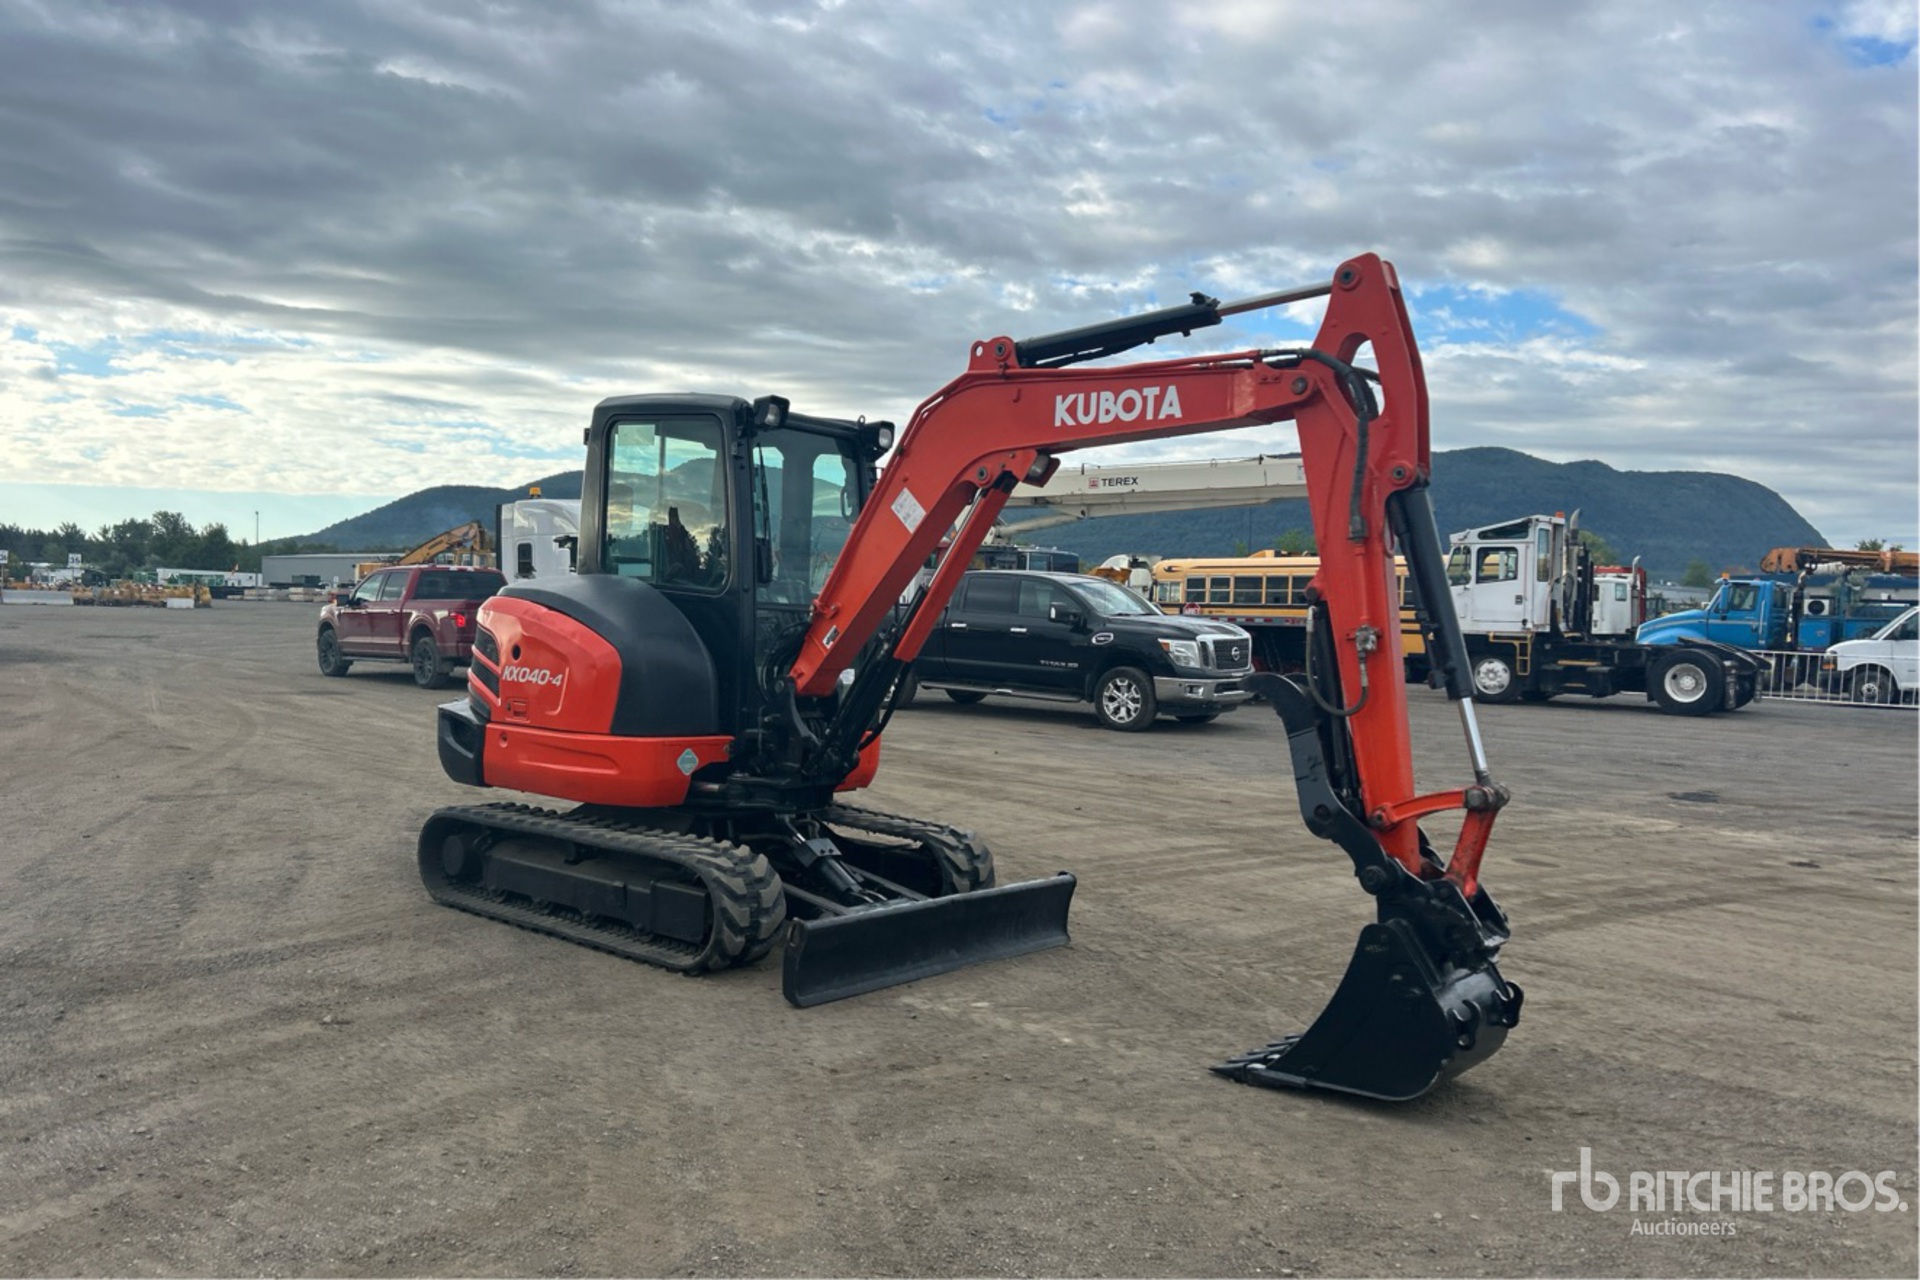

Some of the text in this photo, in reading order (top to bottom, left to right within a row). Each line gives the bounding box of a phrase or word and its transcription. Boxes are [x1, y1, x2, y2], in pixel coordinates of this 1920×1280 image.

[1054, 385, 1183, 427] KUBOTA
[1101, 476, 1139, 487] TEREX
[502, 665, 563, 687] KX040-4
